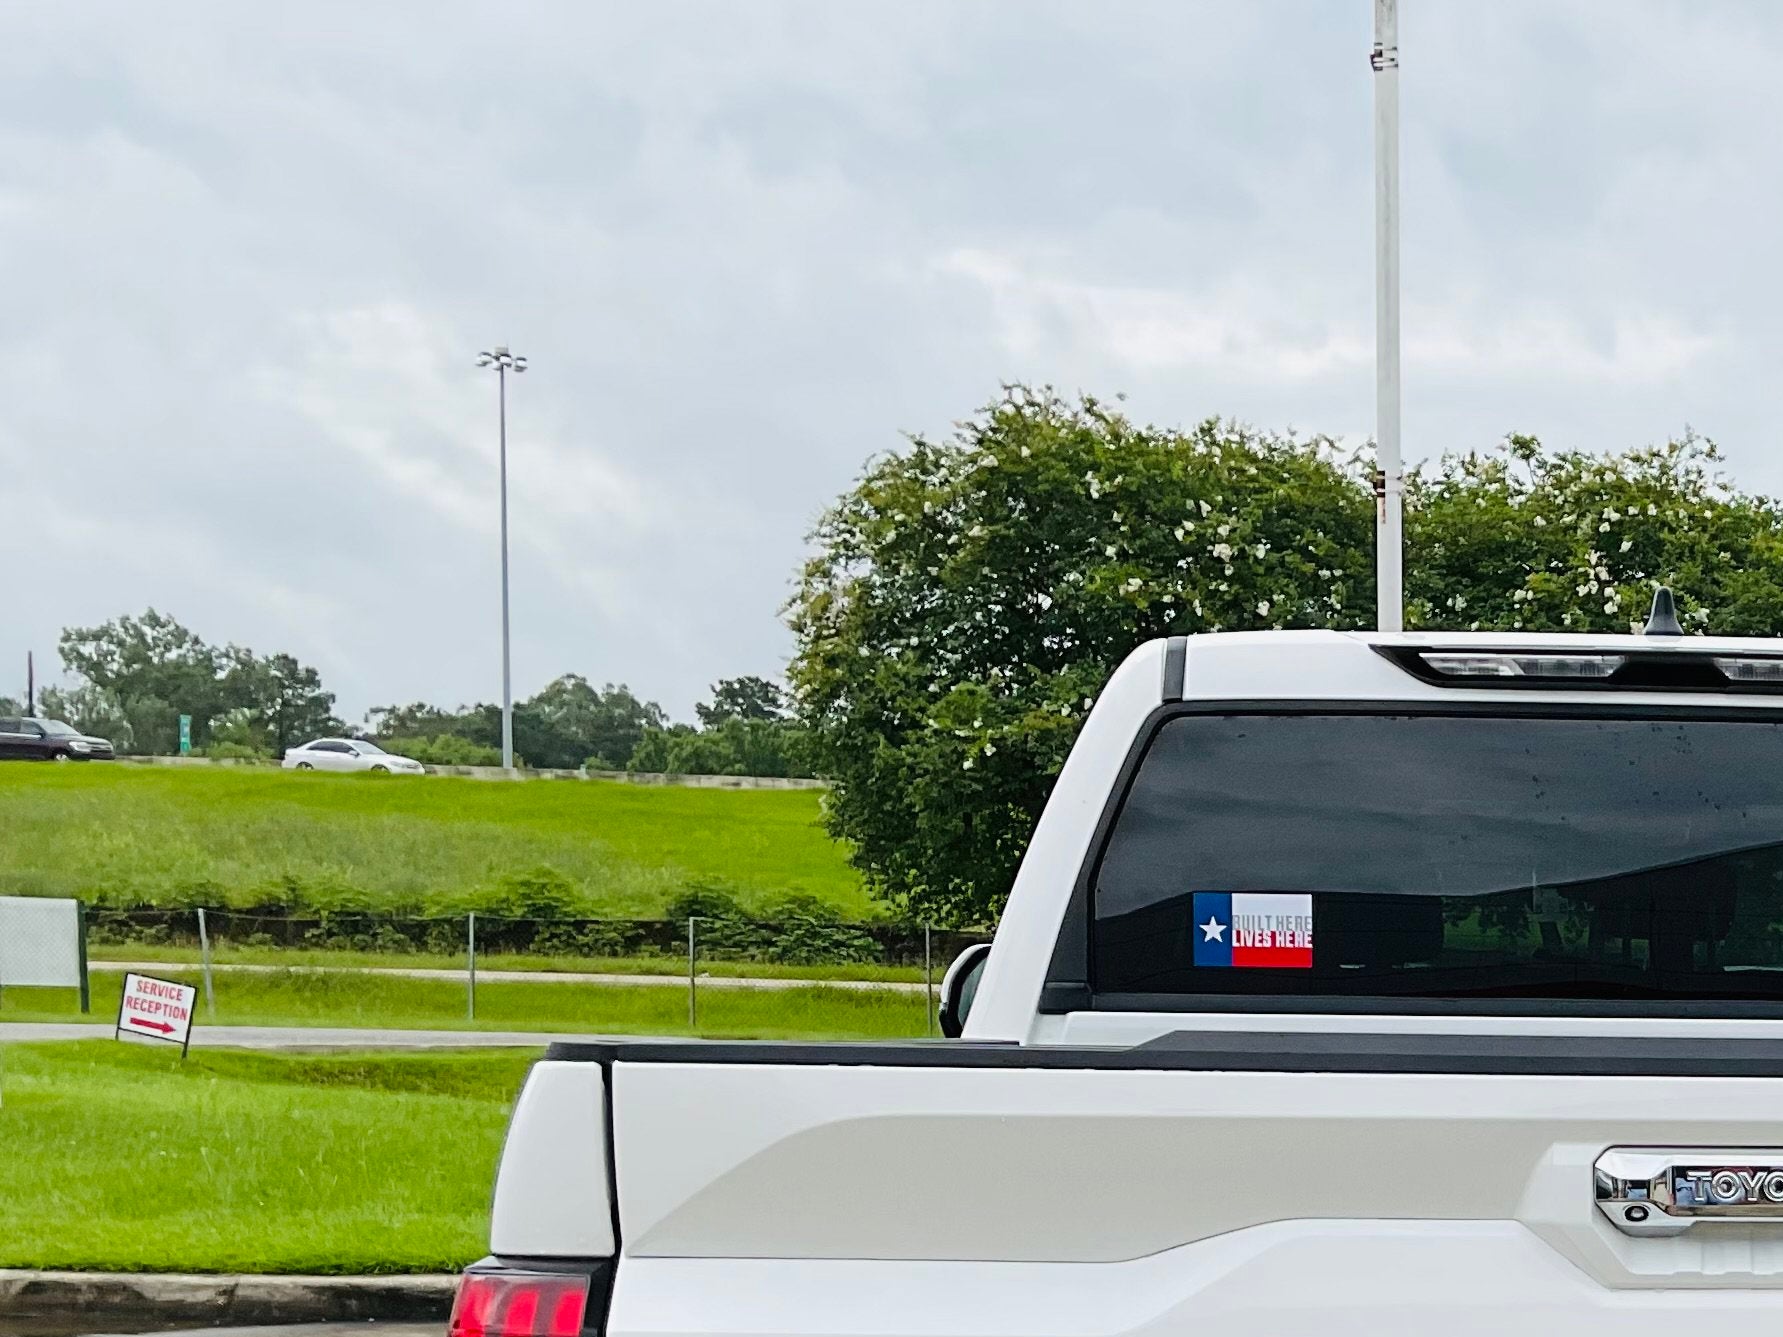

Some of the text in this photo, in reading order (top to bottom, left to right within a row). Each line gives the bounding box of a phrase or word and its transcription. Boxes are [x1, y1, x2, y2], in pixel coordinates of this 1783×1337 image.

[1232, 914, 1312, 932] BUILT HERE
[1232, 929, 1313, 949] LIVES HERE
[136, 980, 184, 1001] SERVICE
[126, 995, 188, 1021] RECEPTION
